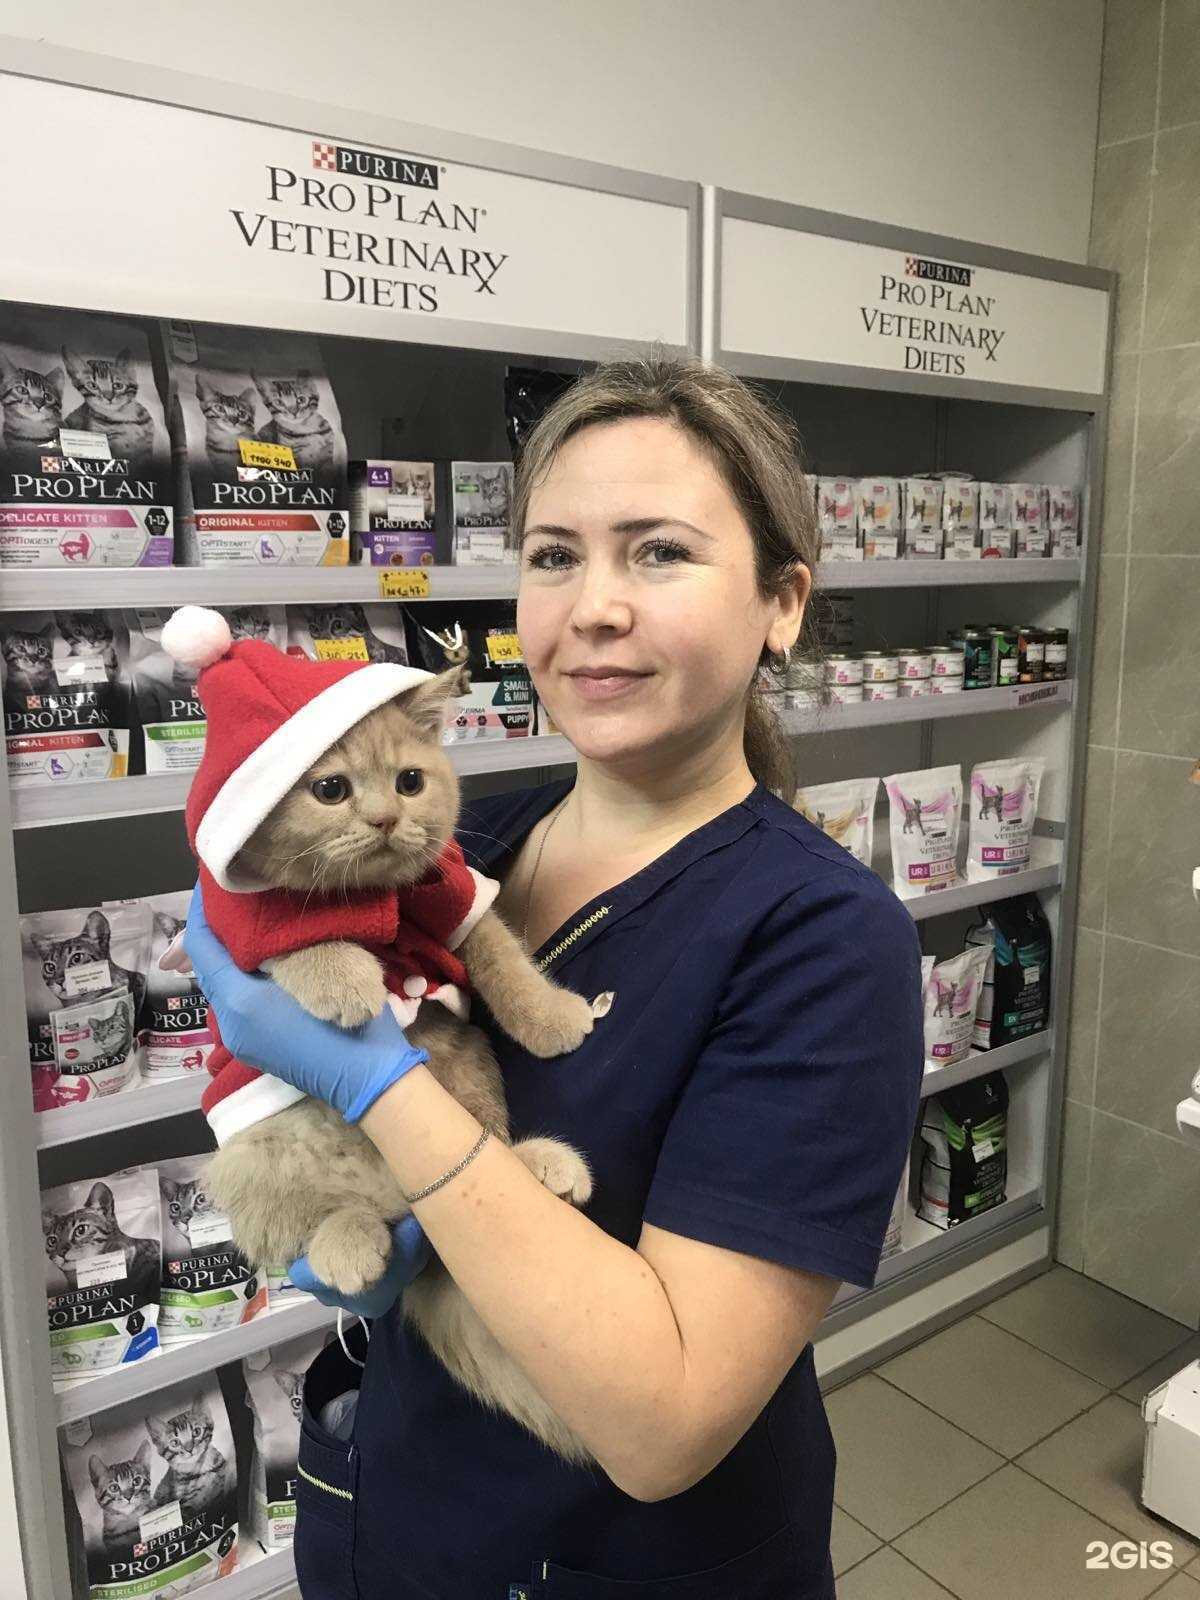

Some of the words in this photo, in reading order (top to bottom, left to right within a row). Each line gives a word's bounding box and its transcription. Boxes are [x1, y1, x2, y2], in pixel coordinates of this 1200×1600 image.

[339, 151, 436, 187] PURINA
[228, 209, 510, 296] VETERINARY
[919, 262, 969, 285] PURINA
[320, 267, 439, 313] DIETS
[860, 306, 1006, 362] VETERINARY
[904, 345, 966, 376] DIETS
[63, 513, 108, 524] KITTEN
[199, 518, 255, 527] ORIGINAL
[503, 680, 529, 692] SMALL
[507, 714, 528, 724] PUPPY
[181, 1254, 230, 1271] PURINA
[58, 1287, 110, 1306] PURINA
[150, 1517, 203, 1550] PURINA
